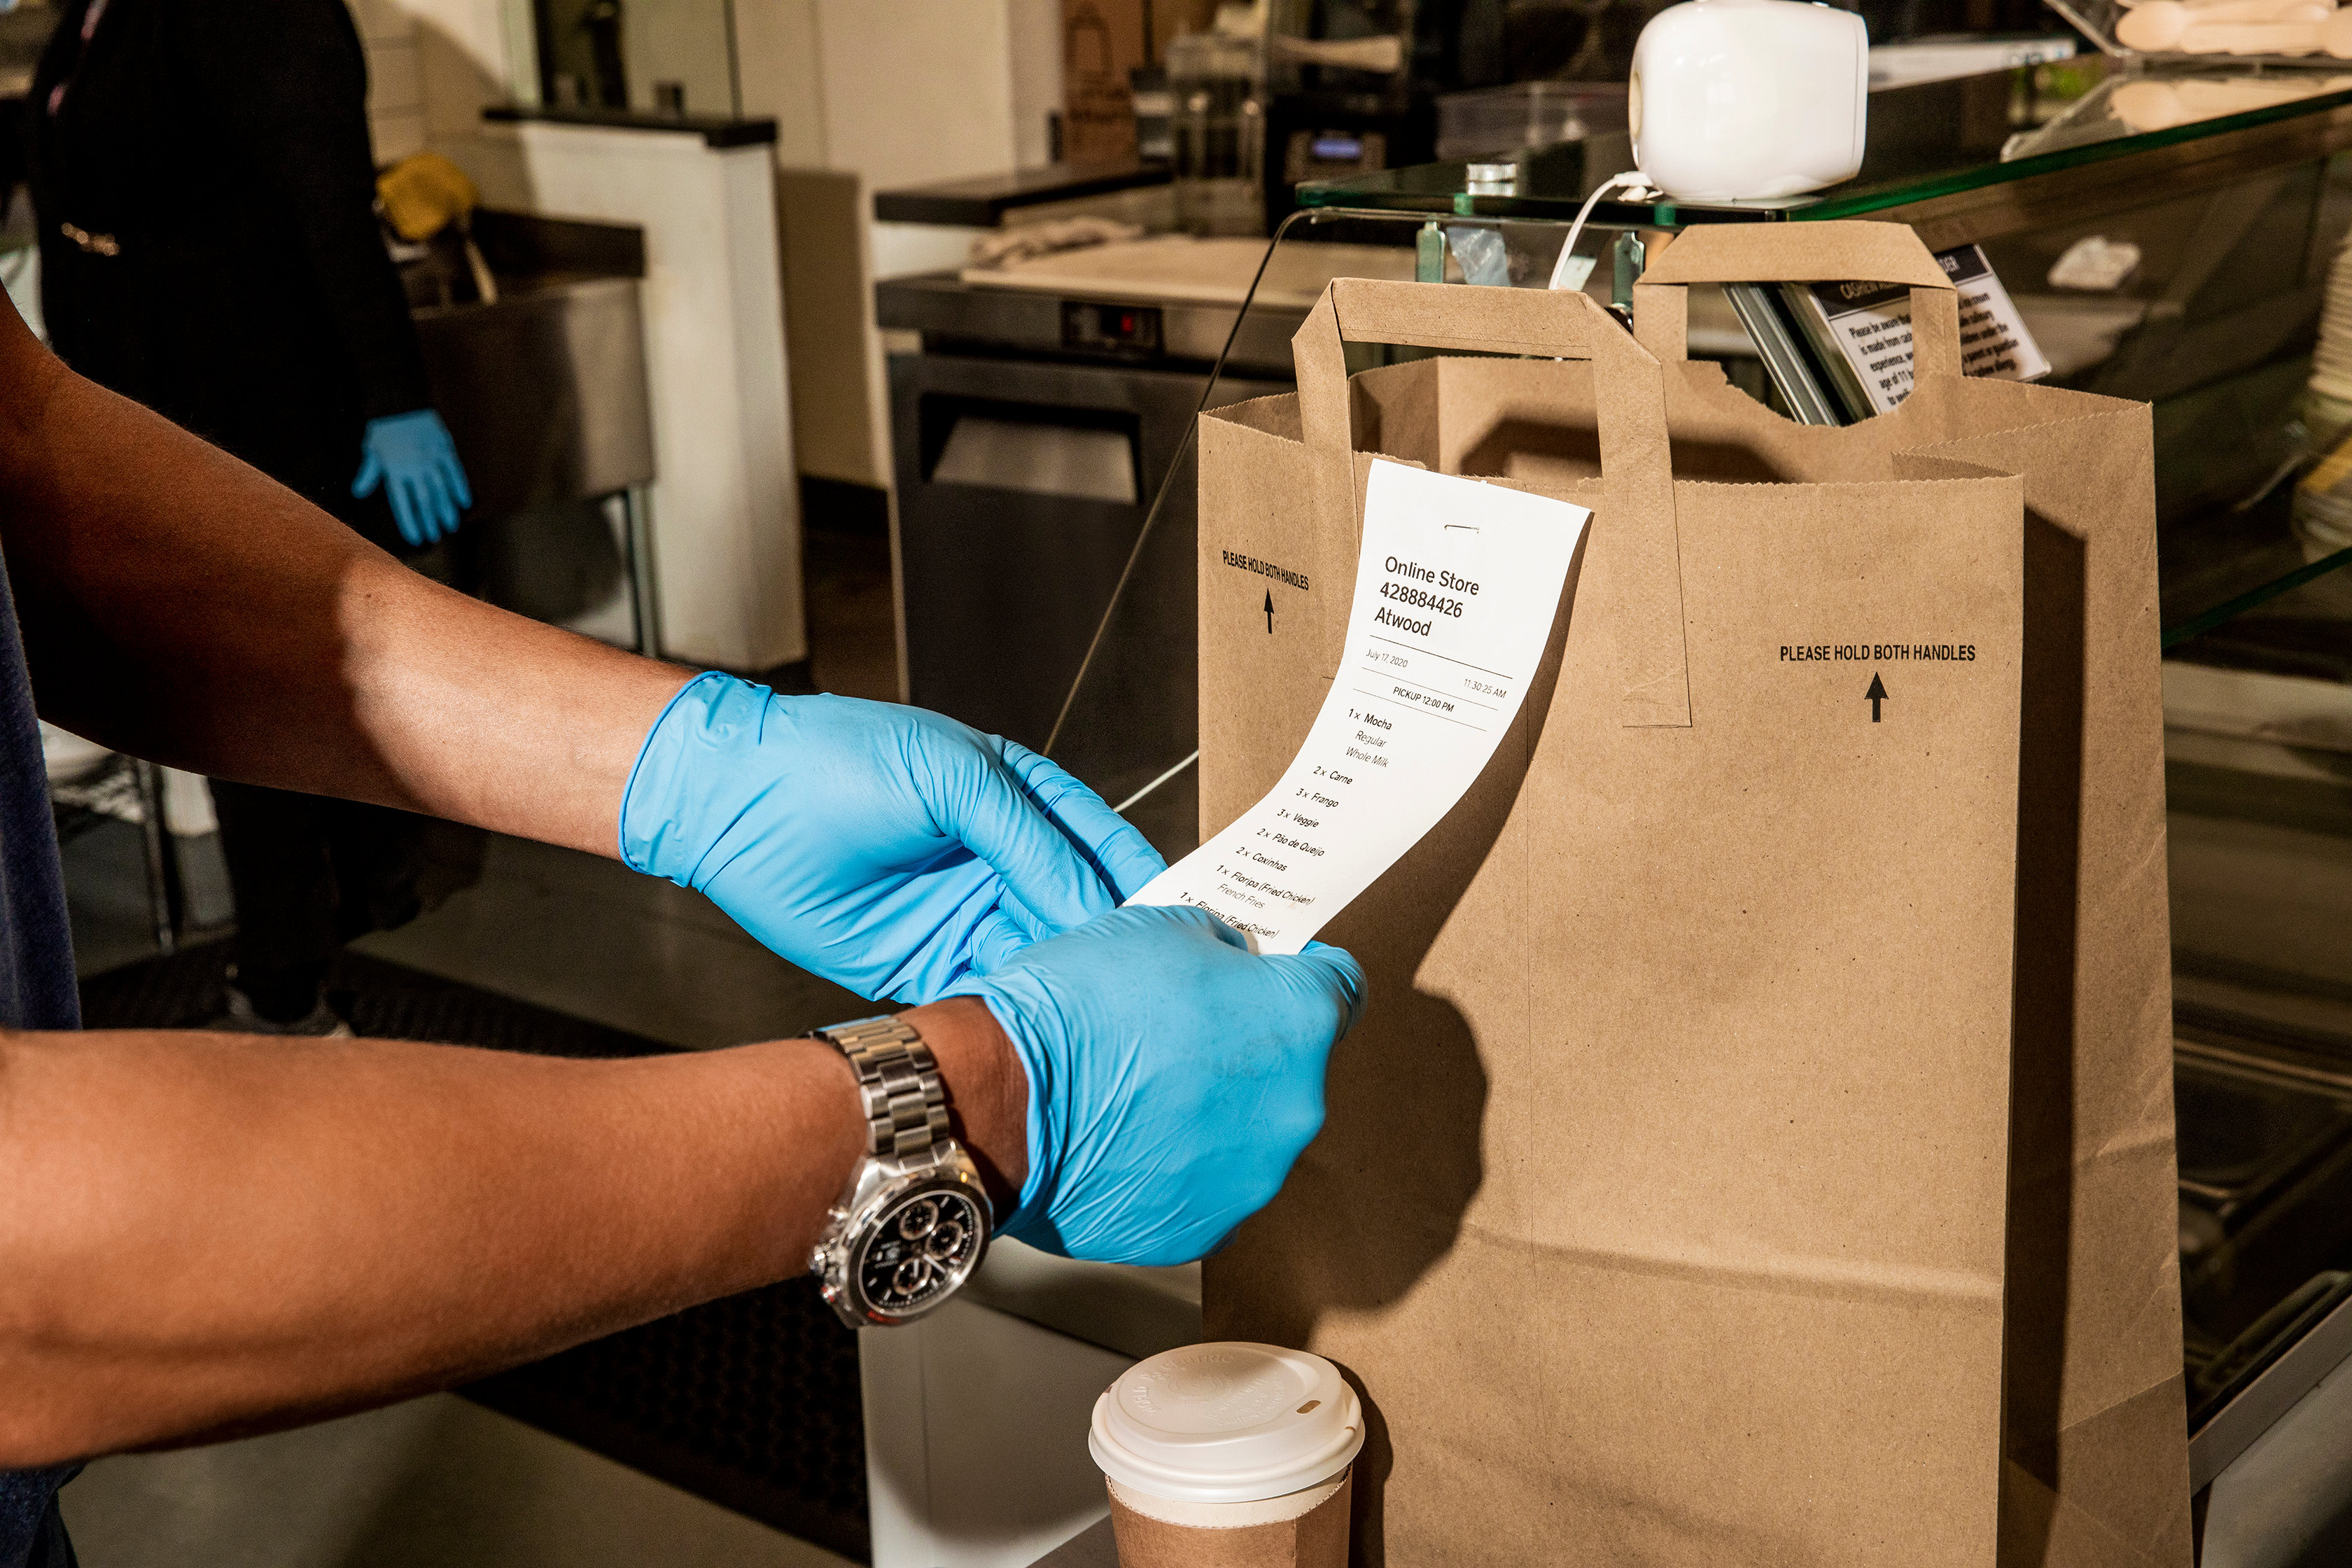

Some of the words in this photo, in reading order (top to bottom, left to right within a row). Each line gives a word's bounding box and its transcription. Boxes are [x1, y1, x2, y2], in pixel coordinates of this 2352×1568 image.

[1849, 326, 1872, 339] Please
[1868, 321, 1881, 333] be
[1858, 344, 1868, 355] is
[1867, 339, 1886, 353] made
[1882, 336, 1900, 347] from
[1879, 378, 1892, 391] age
[1223, 550, 1247, 570] PLEASE
[1248, 556, 1264, 575] HOLD
[1266, 563, 1280, 581] BOTH
[1281, 568, 1308, 591] HANDLES
[1385, 556, 1435, 583] Online
[1439, 570, 1479, 596] Store
[1380, 582, 1463, 618] 428884426
[1374, 606, 1432, 636] Atwood
[1780, 645, 1830, 661] PLEASE
[1834, 645, 1870, 660] HOLD
[1874, 645, 1910, 660] BOTH
[1914, 645, 1975, 661] HANDLES
[1366, 649, 1380, 661] July
[1381, 653, 1390, 663] 17,
[1390, 656, 1408, 668] 2020
[1464, 679, 1493, 694] 11:30:25
[1492, 688, 1507, 699] AM
[1393, 686, 1422, 701] PICKUP
[1423, 696, 1441, 708] 12:00
[1441, 702, 1455, 713] PM
[1364, 713, 1392, 730] Mocha
[1355, 730, 1387, 748] Regular
[1345, 746, 1371, 762] Whole
[1371, 755, 1390, 768] Milk
[1329, 771, 1353, 785] Carne
[1311, 792, 1339, 808] Frango
[1293, 813, 1320, 827] Veggie
[1272, 833, 1288, 844] Pão
[1288, 839, 1299, 848] de
[1300, 842, 1325, 857] Queijo
[1252, 853, 1288, 872] Coxinhas
[1217, 883, 1245, 902] French
[1245, 896, 1266, 909] Fries
[1231, 872, 1259, 888] Floripa
[1258, 882, 1284, 898] (Fried
[1282, 890, 1315, 906] Chicken)
[1224, 915, 1248, 931] (Fried
[1247, 924, 1280, 939] Chicken)
